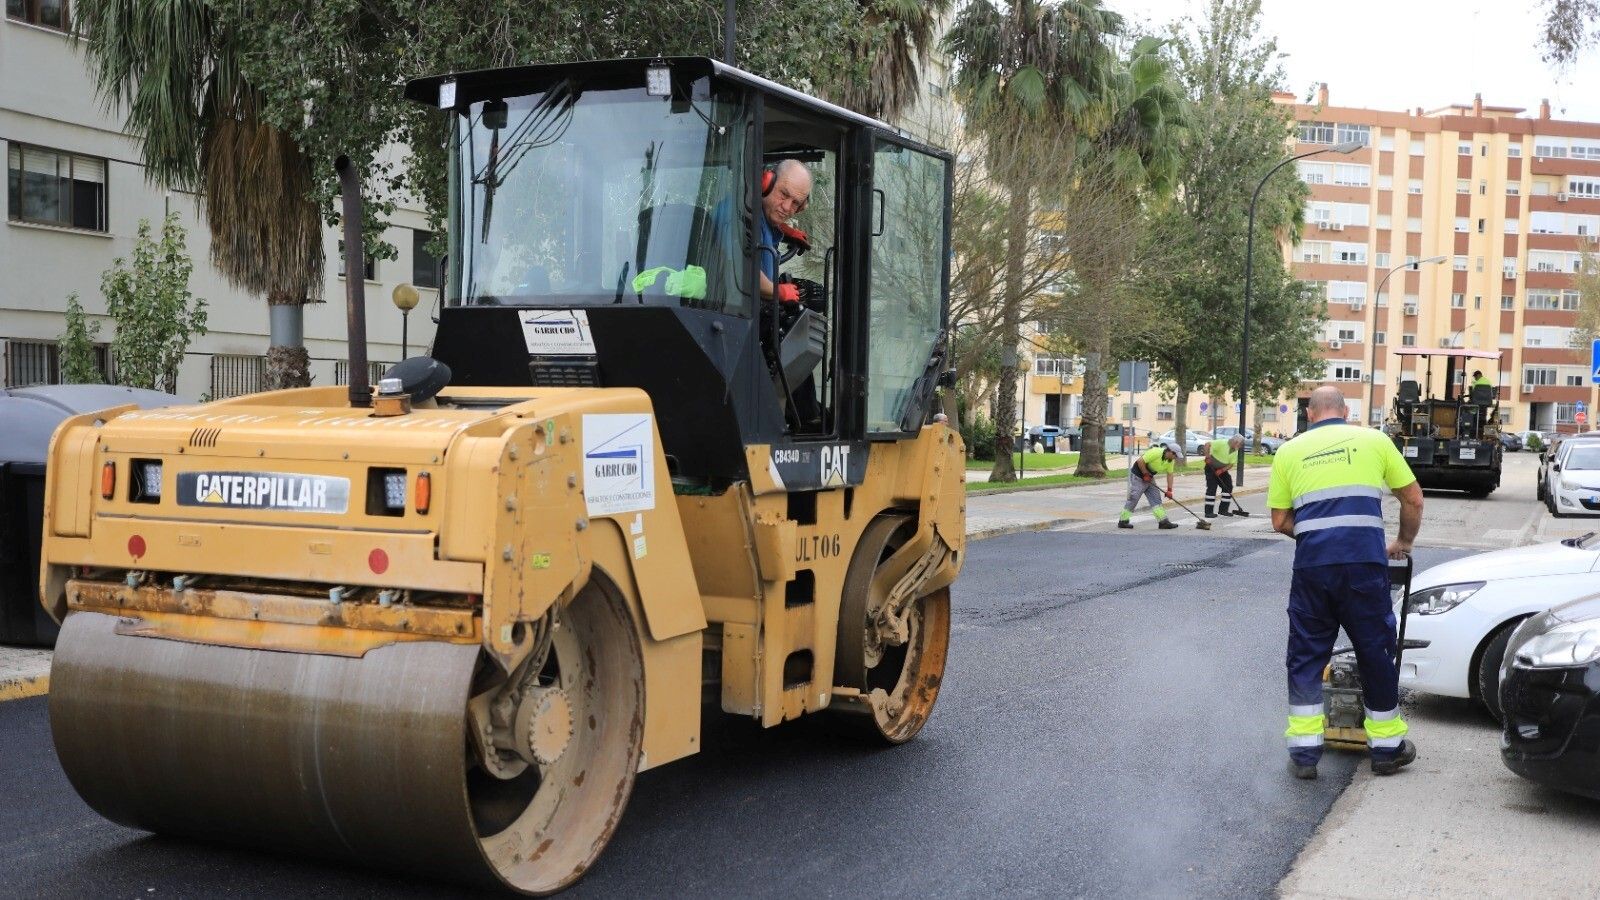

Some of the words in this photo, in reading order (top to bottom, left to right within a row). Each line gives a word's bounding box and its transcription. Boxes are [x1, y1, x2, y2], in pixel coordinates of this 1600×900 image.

[534, 326, 576, 335] GARRUCHO
[594, 462, 638, 478] GARRUCHO
[821, 445, 850, 486] CAT
[195, 474, 327, 508] CATERPILLAR
